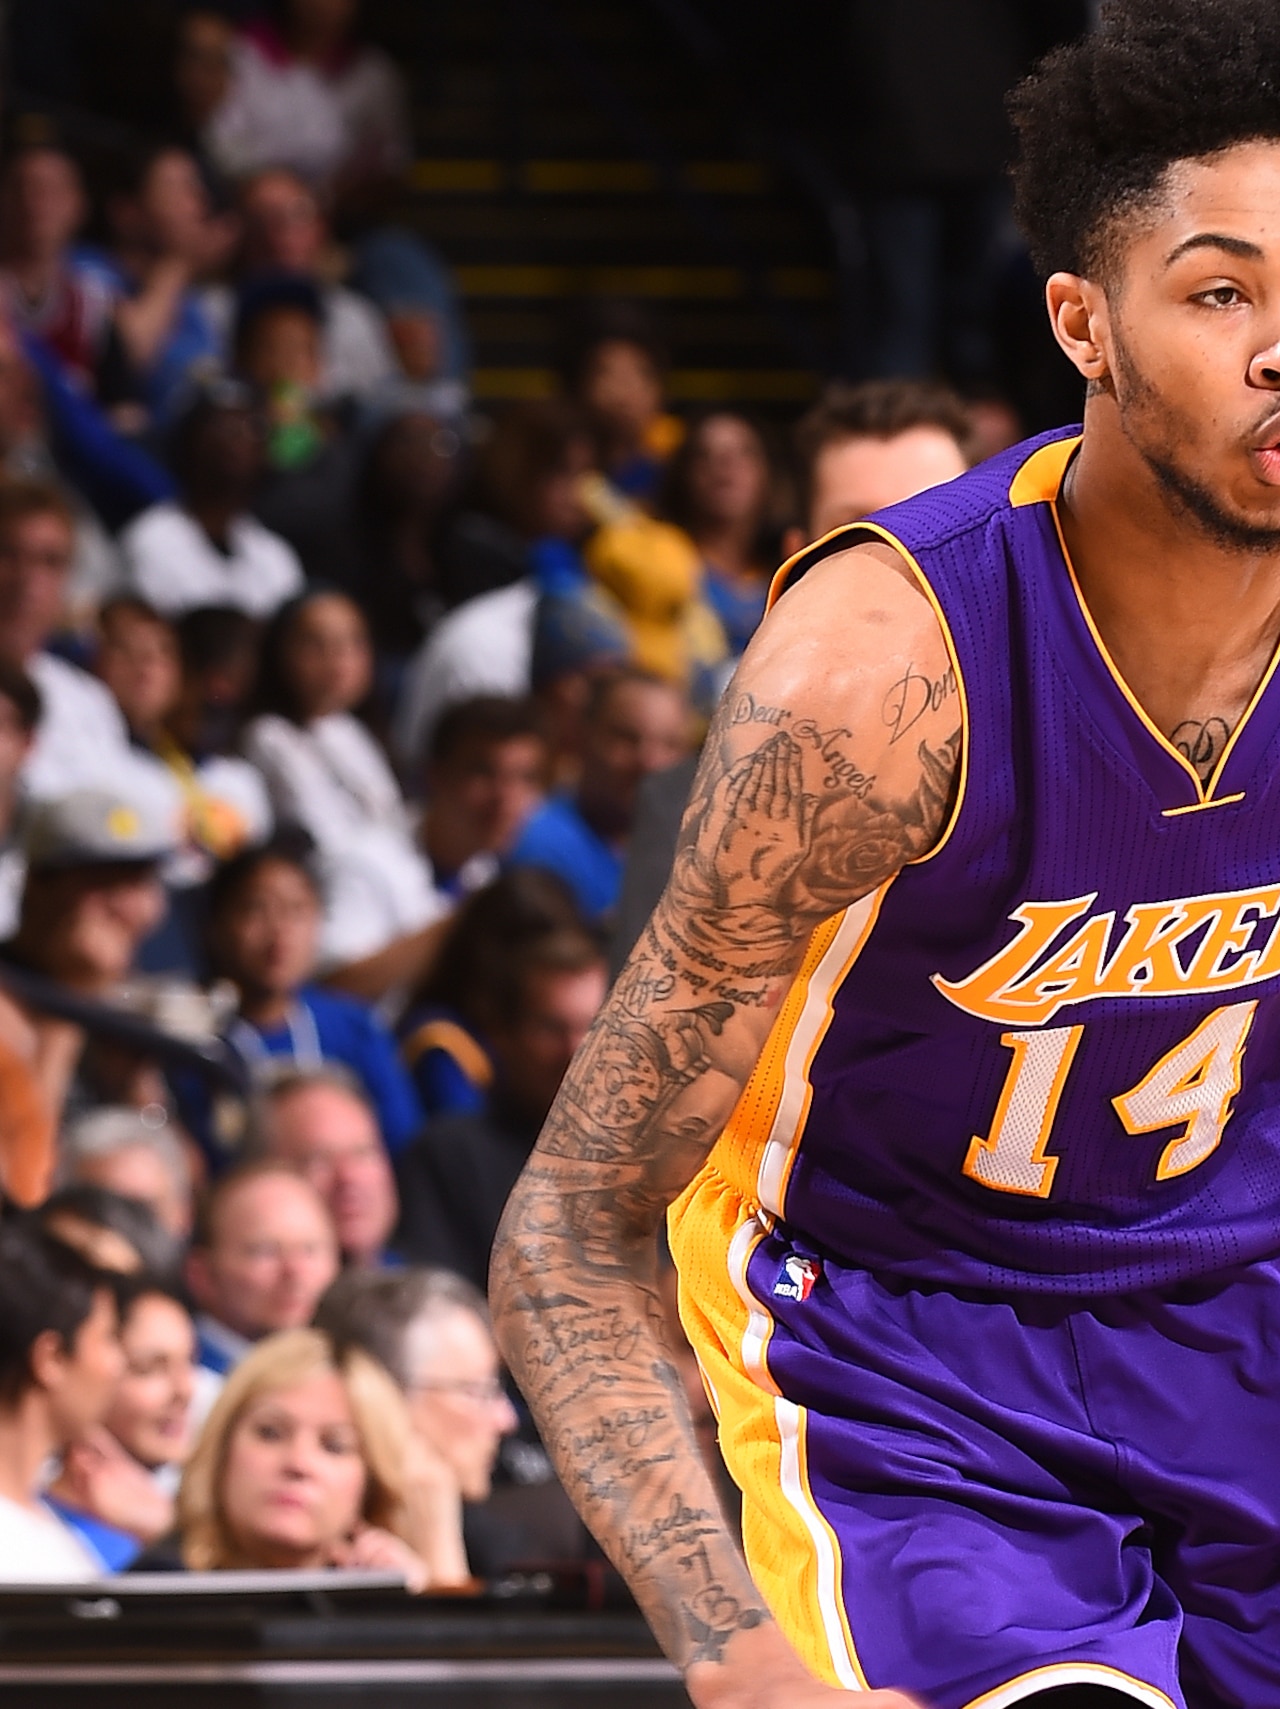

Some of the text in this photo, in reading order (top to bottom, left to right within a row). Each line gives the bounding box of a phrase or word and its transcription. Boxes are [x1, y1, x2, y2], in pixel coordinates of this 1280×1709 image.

[732, 691, 791, 726] Dear
[881, 662, 957, 745] Don
[709, 977, 769, 1007] heart
[962, 999, 1260, 1199] 14
